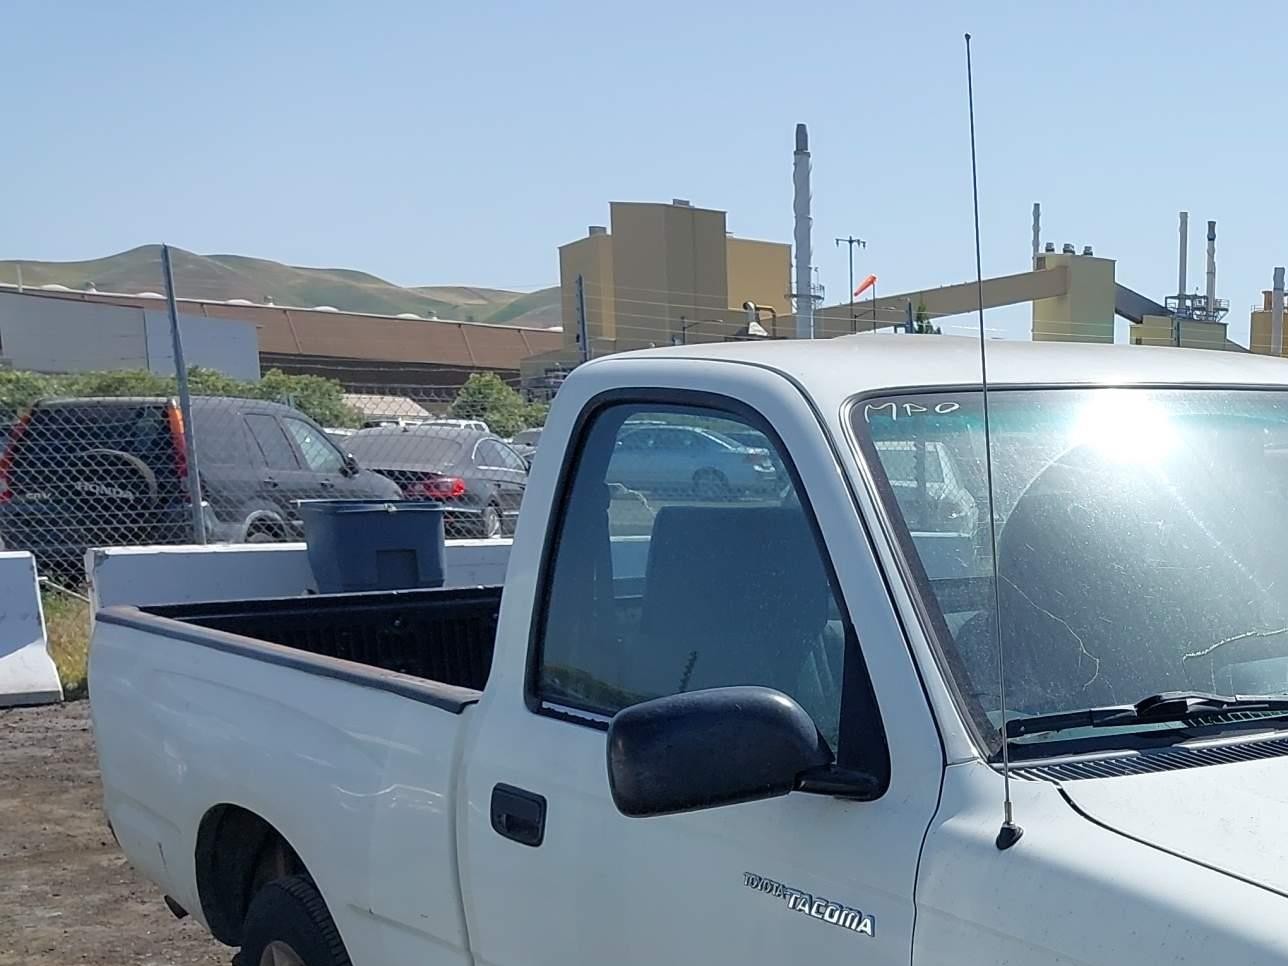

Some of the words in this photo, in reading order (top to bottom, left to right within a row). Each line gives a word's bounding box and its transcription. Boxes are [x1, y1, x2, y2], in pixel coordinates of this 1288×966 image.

[75, 481, 135, 500] HONDA
[743, 872, 786, 898] TOYOTA
[785, 888, 876, 937] TACOMA
